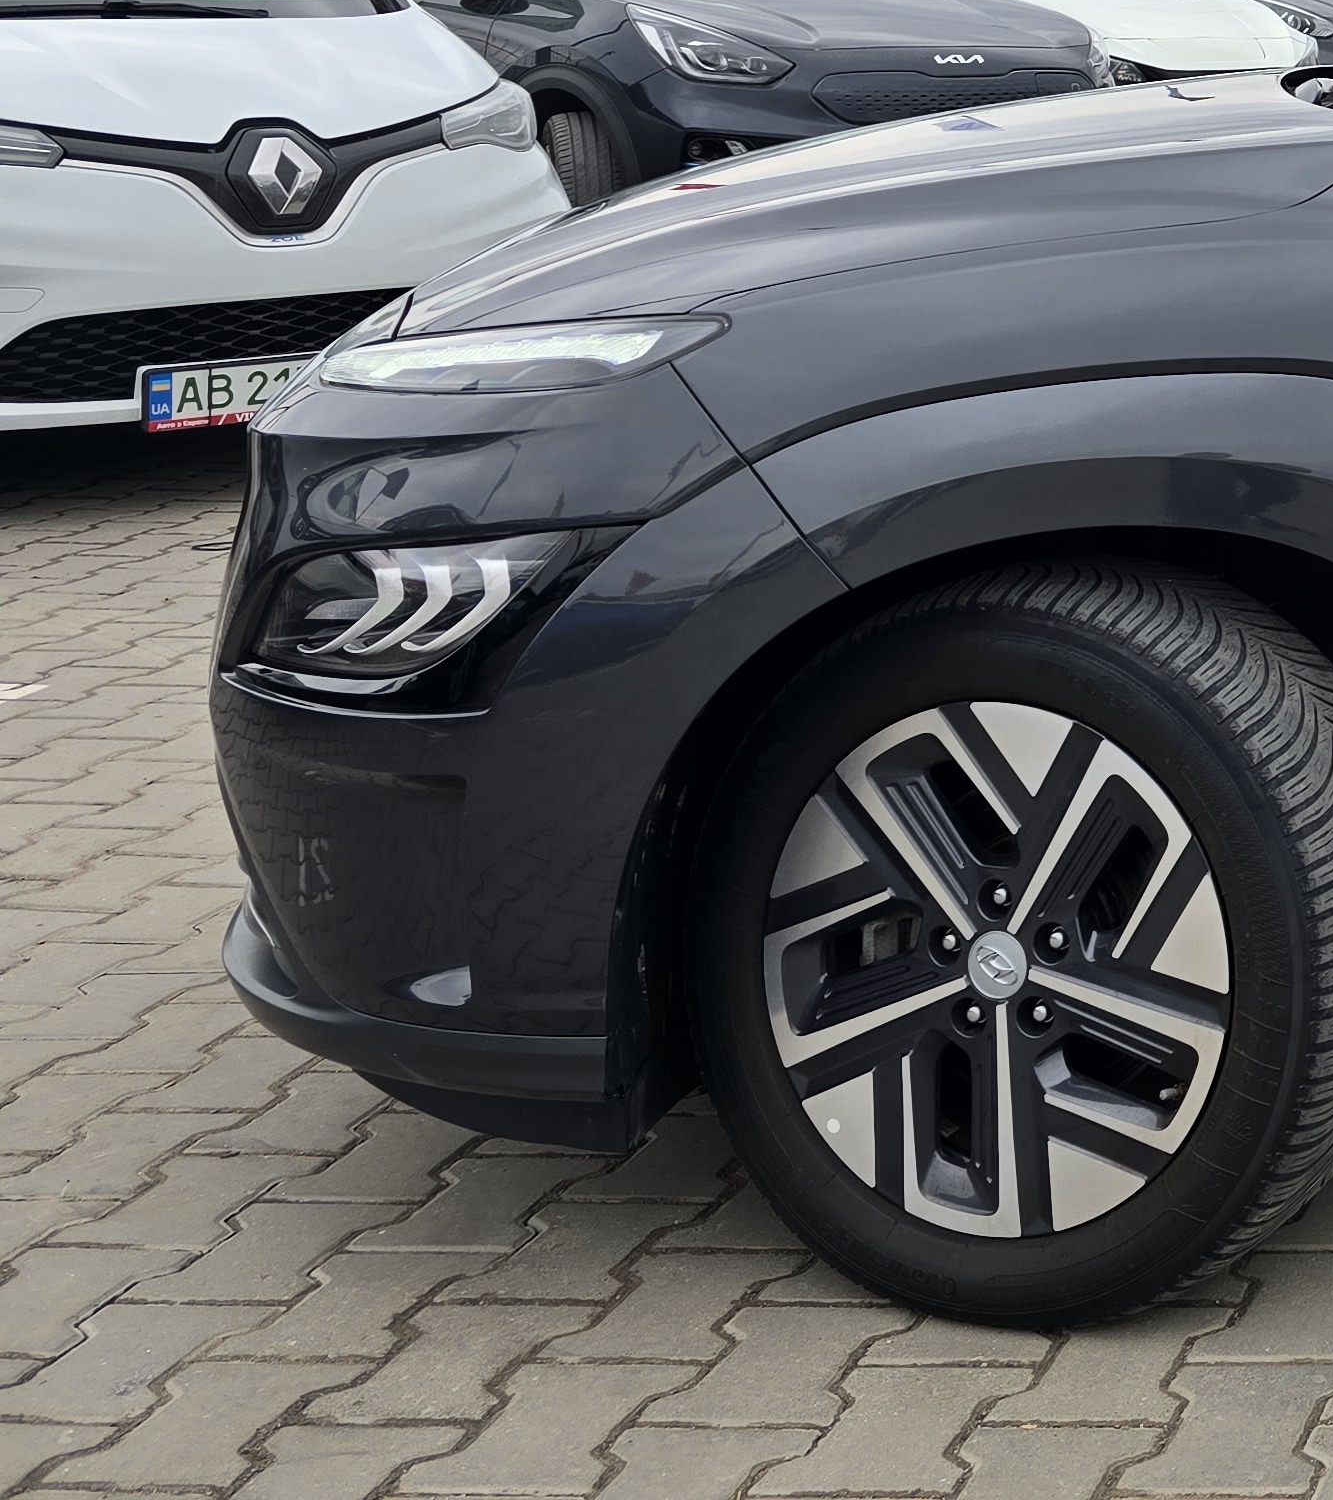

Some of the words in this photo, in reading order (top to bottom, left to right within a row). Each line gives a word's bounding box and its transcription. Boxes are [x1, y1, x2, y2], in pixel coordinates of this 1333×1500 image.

[934, 54, 985, 64] KIA
[177, 373, 235, 414] AB
[151, 402, 170, 415] UA
